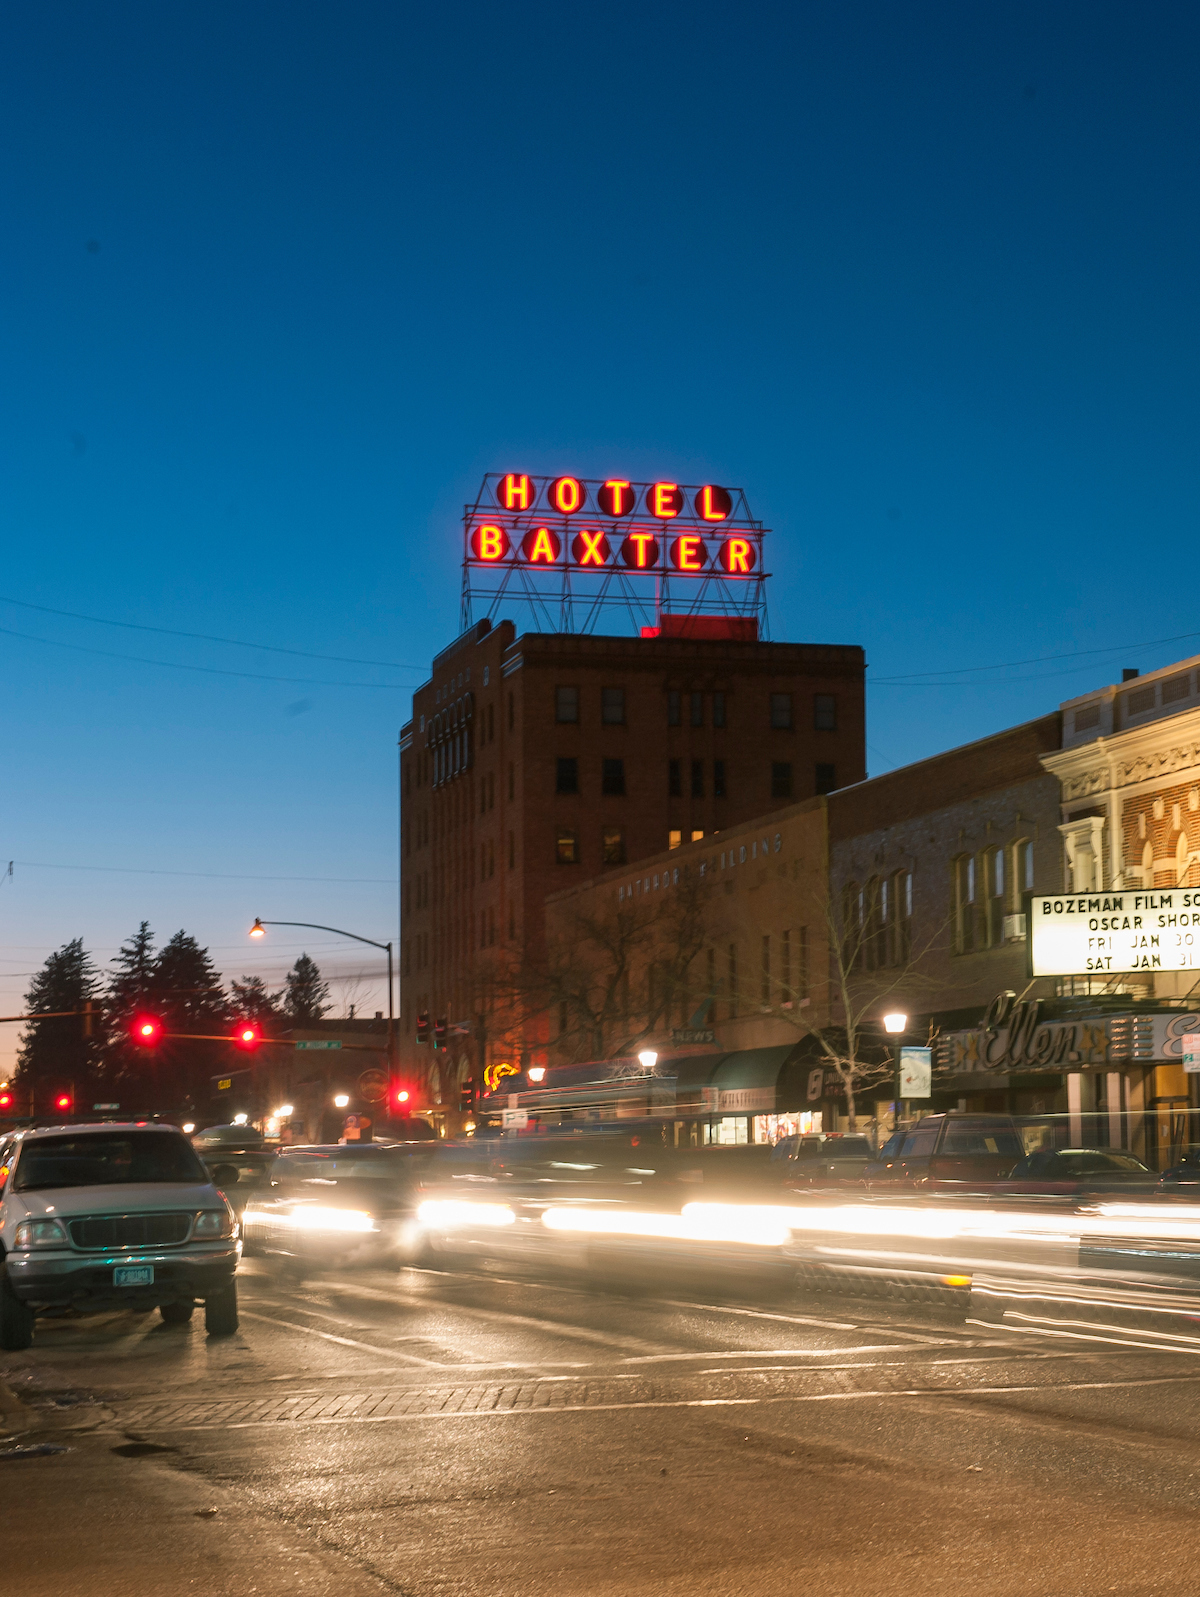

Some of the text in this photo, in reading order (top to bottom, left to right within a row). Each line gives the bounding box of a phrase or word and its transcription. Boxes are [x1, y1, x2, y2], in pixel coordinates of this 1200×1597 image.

[504, 473, 727, 521] HOTEL
[479, 523, 752, 574] BAXTER
[1042, 897, 1124, 915] BOZEMAN
[1134, 894, 1173, 910] FILM
[1088, 916, 1143, 931] OSCAR
[1088, 936, 1112, 950] FRI
[1130, 934, 1160, 949] JAN
[1175, 933, 1194, 947] 30
[1086, 956, 1113, 970] SAT
[1130, 953, 1161, 968] JAN
[1178, 952, 1193, 966] 31
[980, 989, 1080, 1068] Ellen
